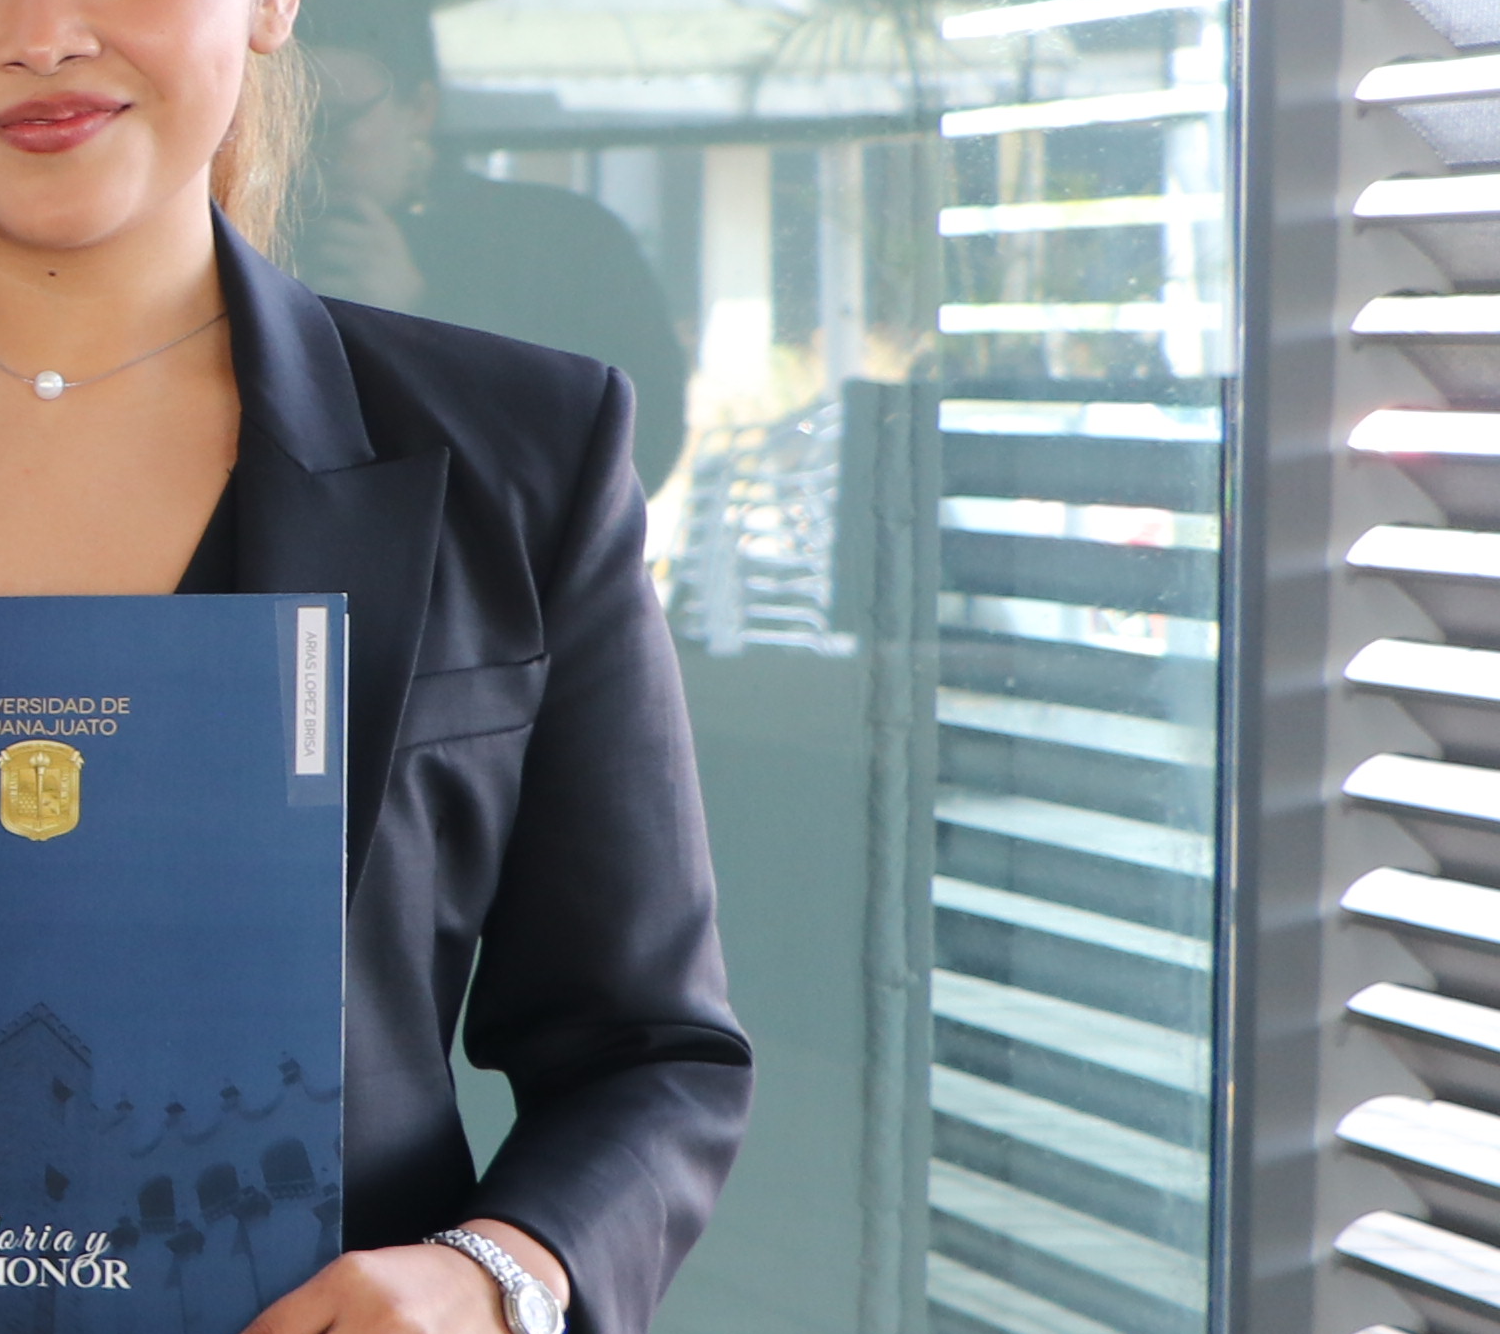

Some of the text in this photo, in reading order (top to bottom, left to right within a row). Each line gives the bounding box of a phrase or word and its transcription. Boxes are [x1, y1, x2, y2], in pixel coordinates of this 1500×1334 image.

[101, 697, 130, 714] DE
[303, 630, 318, 757] ARIAS LOPEZ BRISA
[75, 1232, 111, 1268] y
